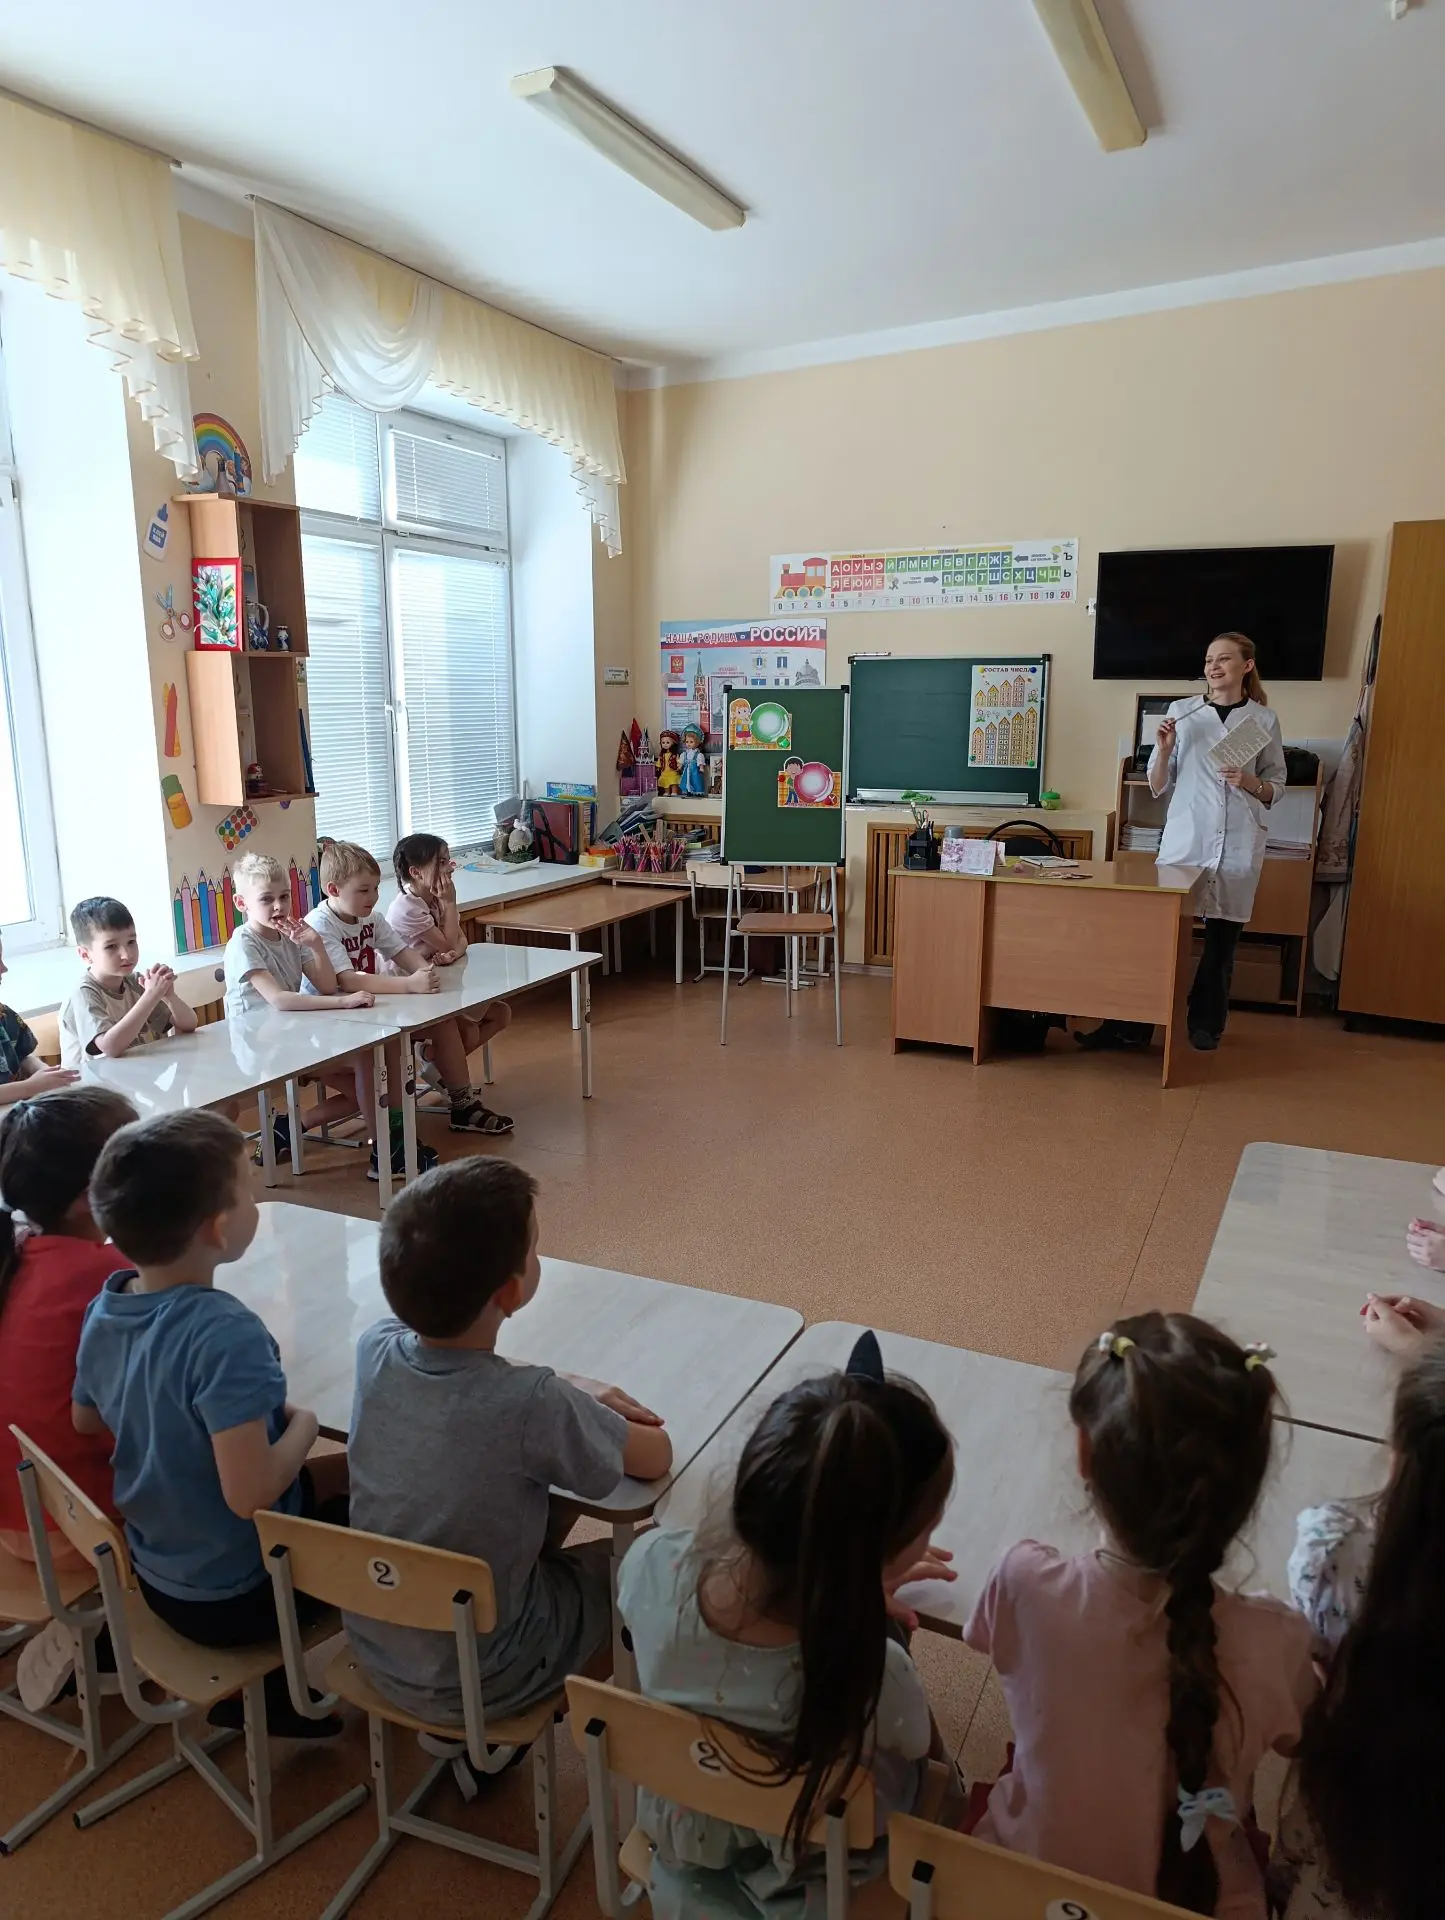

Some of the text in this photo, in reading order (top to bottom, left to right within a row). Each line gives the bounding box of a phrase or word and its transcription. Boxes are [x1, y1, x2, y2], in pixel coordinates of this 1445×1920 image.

[832, 552, 1073, 573] А О У Ы Э Й Л М Н Р Б В Г Д Ж З Ъ
[832, 580, 840, 589] Я
[853, 579, 862, 588] Ю
[865, 579, 873, 587] И
[876, 578, 883, 587] Е
[943, 574, 952, 584] П
[954, 574, 963, 583] Ф
[967, 573, 975, 582] К
[979, 572, 987, 582] Т
[989, 572, 1000, 581] Ш
[1002, 571, 1010, 580] С
[1014, 571, 1022, 580] Х
[1026, 570, 1035, 581] Ц
[1039, 569, 1047, 579] Ч
[1063, 569, 1072, 578] Ь
[778, 602, 783, 610] 0
[791, 602, 795, 610] 1
[817, 601, 822, 609] 3
[843, 600, 849, 608] 5
[899, 597, 904, 605] 9
[912, 597, 921, 605] 10
[926, 596, 934, 604] 11
[941, 595, 949, 604] 12
[955, 595, 964, 603] 13
[969, 594, 978, 602] 14
[984, 593, 993, 602] 15
[999, 593, 1009, 601] 16
[1014, 592, 1024, 601] 17
[1029, 592, 1039, 600] 18
[1045, 591, 1055, 599] 19
[1060, 590, 1071, 599] 20
[665, 632, 694, 644] НАША
[697, 632, 738, 645] РОДИНА
[750, 626, 820, 642] РОССИЯ
[381, 1070, 387, 1082] 2
[407, 1064, 414, 1076] 2
[373, 1561, 395, 1587] 2
[697, 1741, 721, 1772] 2
